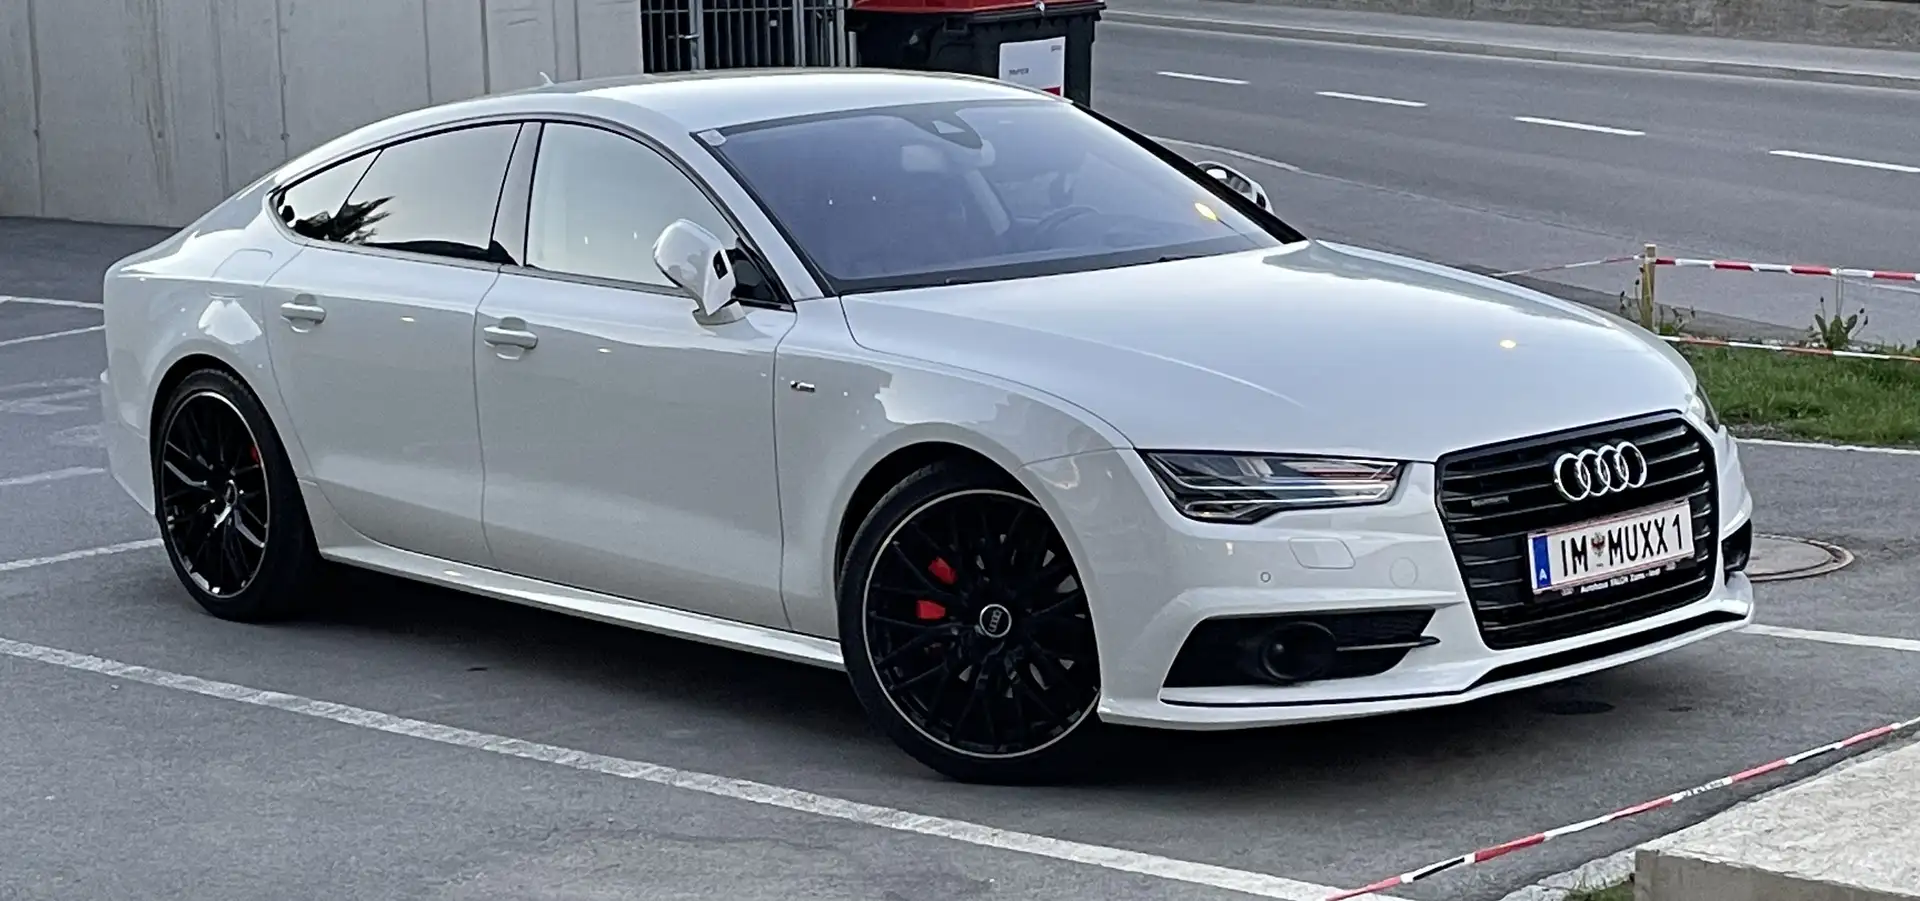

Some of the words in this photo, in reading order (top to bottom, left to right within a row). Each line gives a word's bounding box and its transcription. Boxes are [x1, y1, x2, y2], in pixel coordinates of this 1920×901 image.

[1561, 535, 1588, 577] IM
[1608, 517, 1668, 566] MUXX
[1672, 513, 1683, 550] 1
[1539, 568, 1548, 581] A
